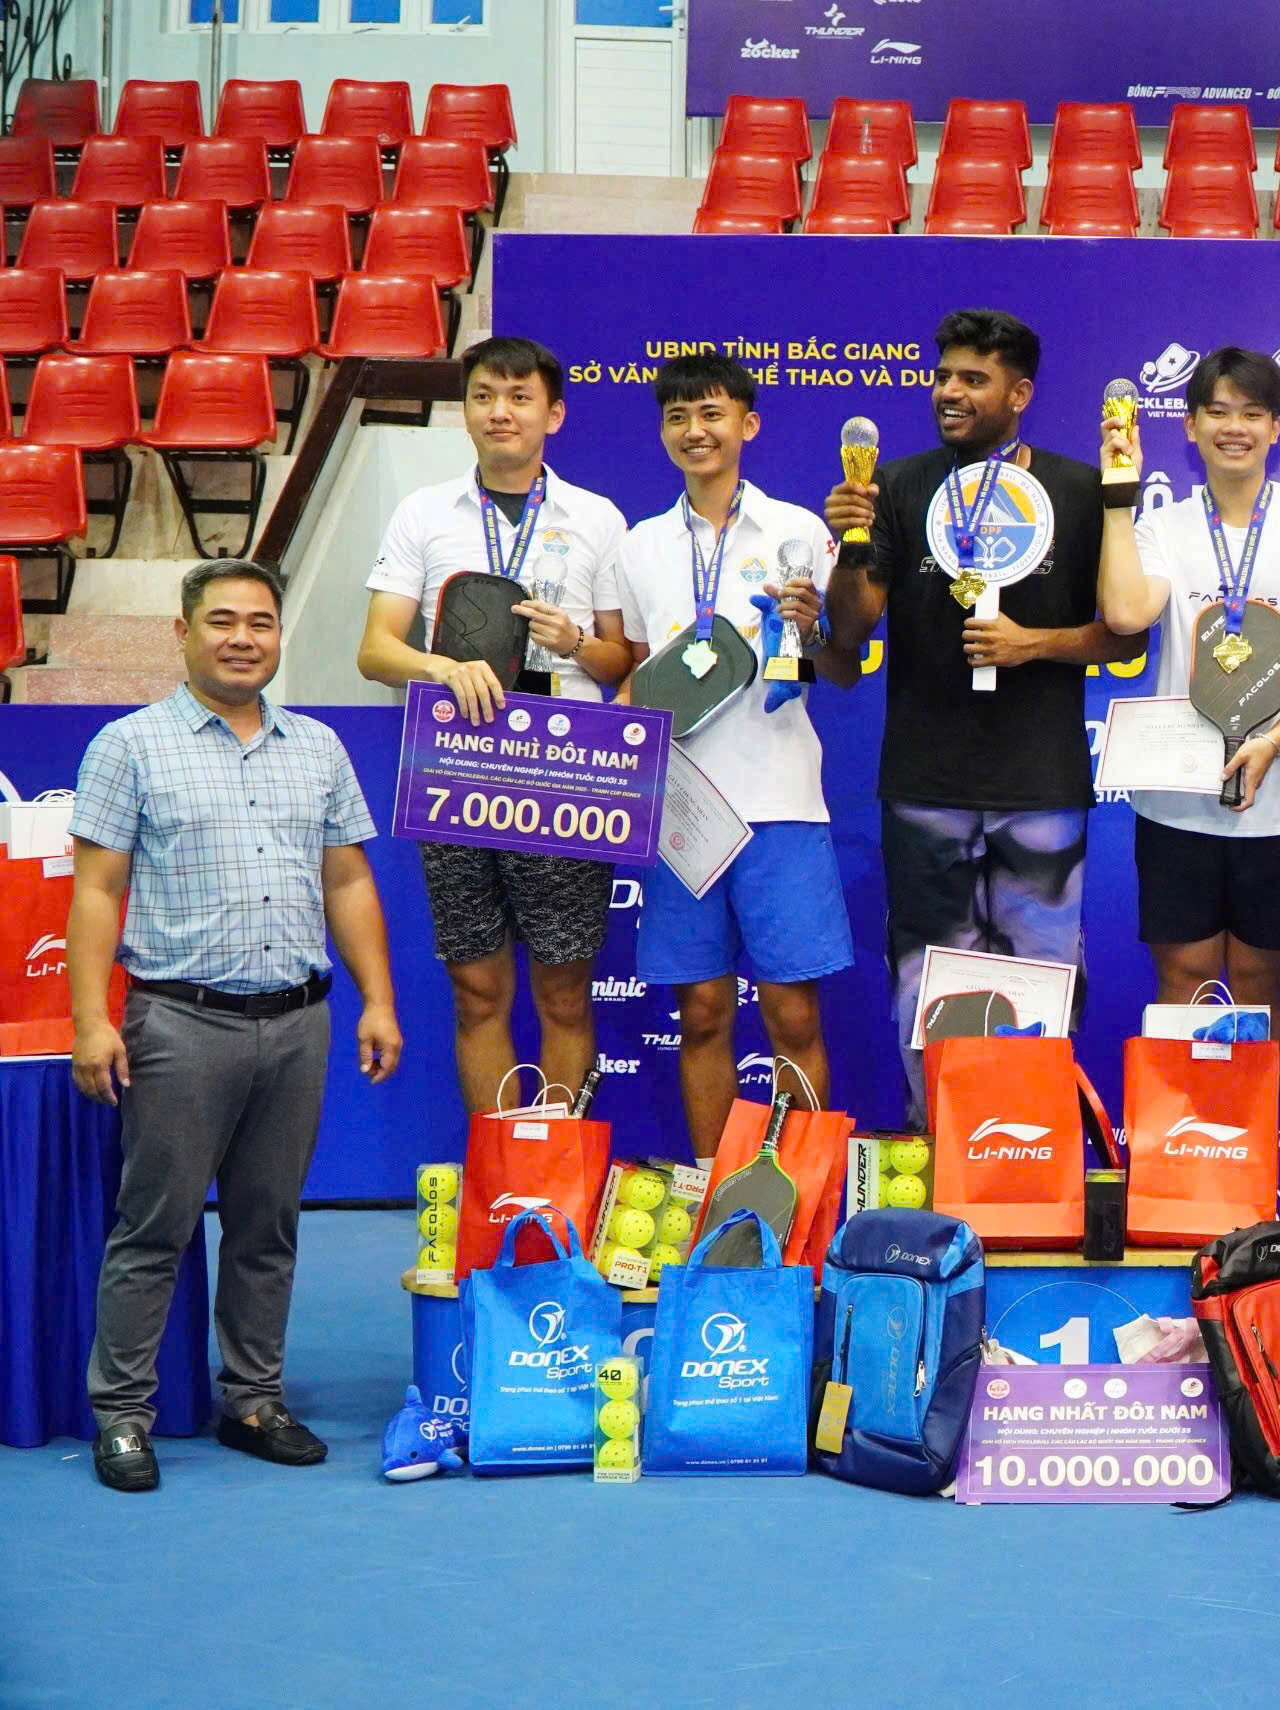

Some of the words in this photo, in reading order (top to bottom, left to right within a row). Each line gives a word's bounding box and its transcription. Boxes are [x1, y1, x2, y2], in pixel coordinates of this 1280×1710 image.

[805, 27, 865, 36] THUNDER
[871, 56, 921, 64] LI-NING
[1127, 84, 1153, 97] BÓNG
[1202, 88, 1251, 99] ADVANCED
[646, 341, 714, 358] UBND
[723, 336, 779, 359] TỈNH
[788, 336, 837, 360] BẮC
[844, 343, 920, 361] GIANG
[569, 362, 602, 383] SỞ
[608, 364, 657, 384] VĂN
[751, 363, 779, 385] HỂ
[786, 368, 853, 386] THAO
[859, 364, 897, 387] VÀ
[900, 369, 935, 387] DU
[1239, 662, 1280, 706] FACOLOS
[435, 731, 494, 755] HẠNG
[500, 737, 540, 759] NHÌ
[545, 742, 587, 765] ĐÔI
[592, 750, 639, 770] NAM
[438, 756, 454, 765] NỘI
[480, 761, 513, 772] CHUYÊN
[513, 765, 544, 776] NGHIỆP
[548, 769, 573, 779] NHÓM
[617, 778, 628, 786] 35
[426, 787, 631, 844] 7.000.000
[968, 1147, 1053, 1160] LI-NING
[1164, 1142, 1248, 1160] LI-NING
[428, 1176, 438, 1263] FACOLOS
[615, 1260, 648, 1274] PRO-T1
[901, 1252, 933, 1267] DONEX
[1040, 1317, 1089, 1365] 1
[508, 1344, 590, 1367] DONEX
[546, 1363, 593, 1380] Sport
[599, 1369, 621, 1381] 40
[680, 1359, 769, 1378] DONEX
[718, 1375, 769, 1391] Sport
[983, 1405, 1043, 1424] HẠNG
[1050, 1402, 1107, 1421] NHẤT
[1113, 1402, 1154, 1420] ĐÔI
[1161, 1405, 1207, 1419] NAM
[975, 1454, 1214, 1487] 10.000.000
